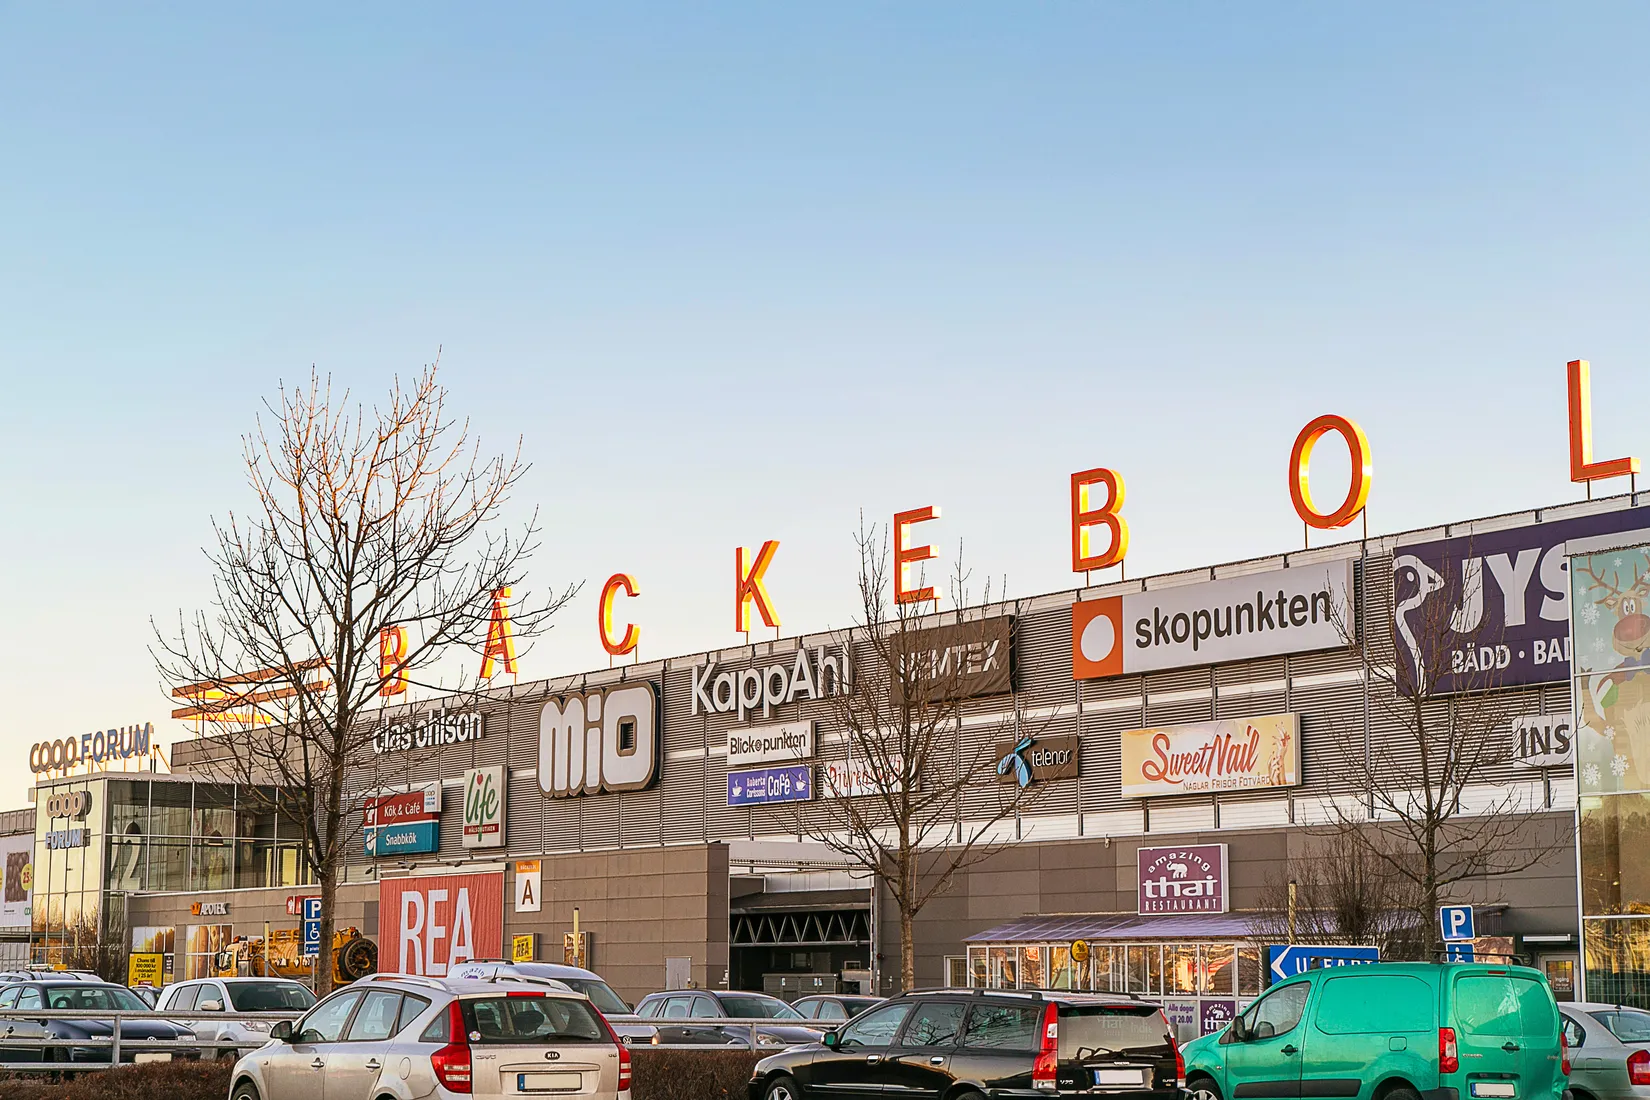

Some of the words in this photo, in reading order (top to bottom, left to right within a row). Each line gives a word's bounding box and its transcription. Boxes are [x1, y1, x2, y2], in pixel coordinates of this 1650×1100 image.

[1134, 588, 1332, 651] skopunkten
[1451, 642, 1511, 674] BÄDD
[691, 641, 849, 721] KappAhl
[372, 716, 412, 754] clas
[415, 707, 482, 748] ohlson
[1519, 724, 1570, 758] INS
[81, 722, 151, 765] FORUM
[1142, 733, 1209, 784] Sweet
[1206, 725, 1260, 777] Nail
[1032, 749, 1072, 767] telenor
[768, 773, 790, 797] Café
[1183, 780, 1209, 791] NAGLAR
[1211, 776, 1237, 789] FRISÖR
[1239, 772, 1271, 787] FOTVÅRD
[384, 804, 396, 817] Kök
[397, 803, 403, 816] &
[405, 801, 421, 815] Café
[46, 829, 83, 850] FORUM
[385, 832, 417, 846] Snabbkök
[1147, 851, 1211, 874] amazing
[522, 879, 534, 905] A
[1142, 874, 1218, 898] thai
[200, 902, 226, 915] APOTEK
[311, 901, 321, 918] P
[1145, 898, 1218, 911] RESTAURANT
[399, 887, 475, 976] REA
[1451, 909, 1466, 937] P
[516, 942, 529, 958] REA
[1177, 1015, 1193, 1024] 20.00
